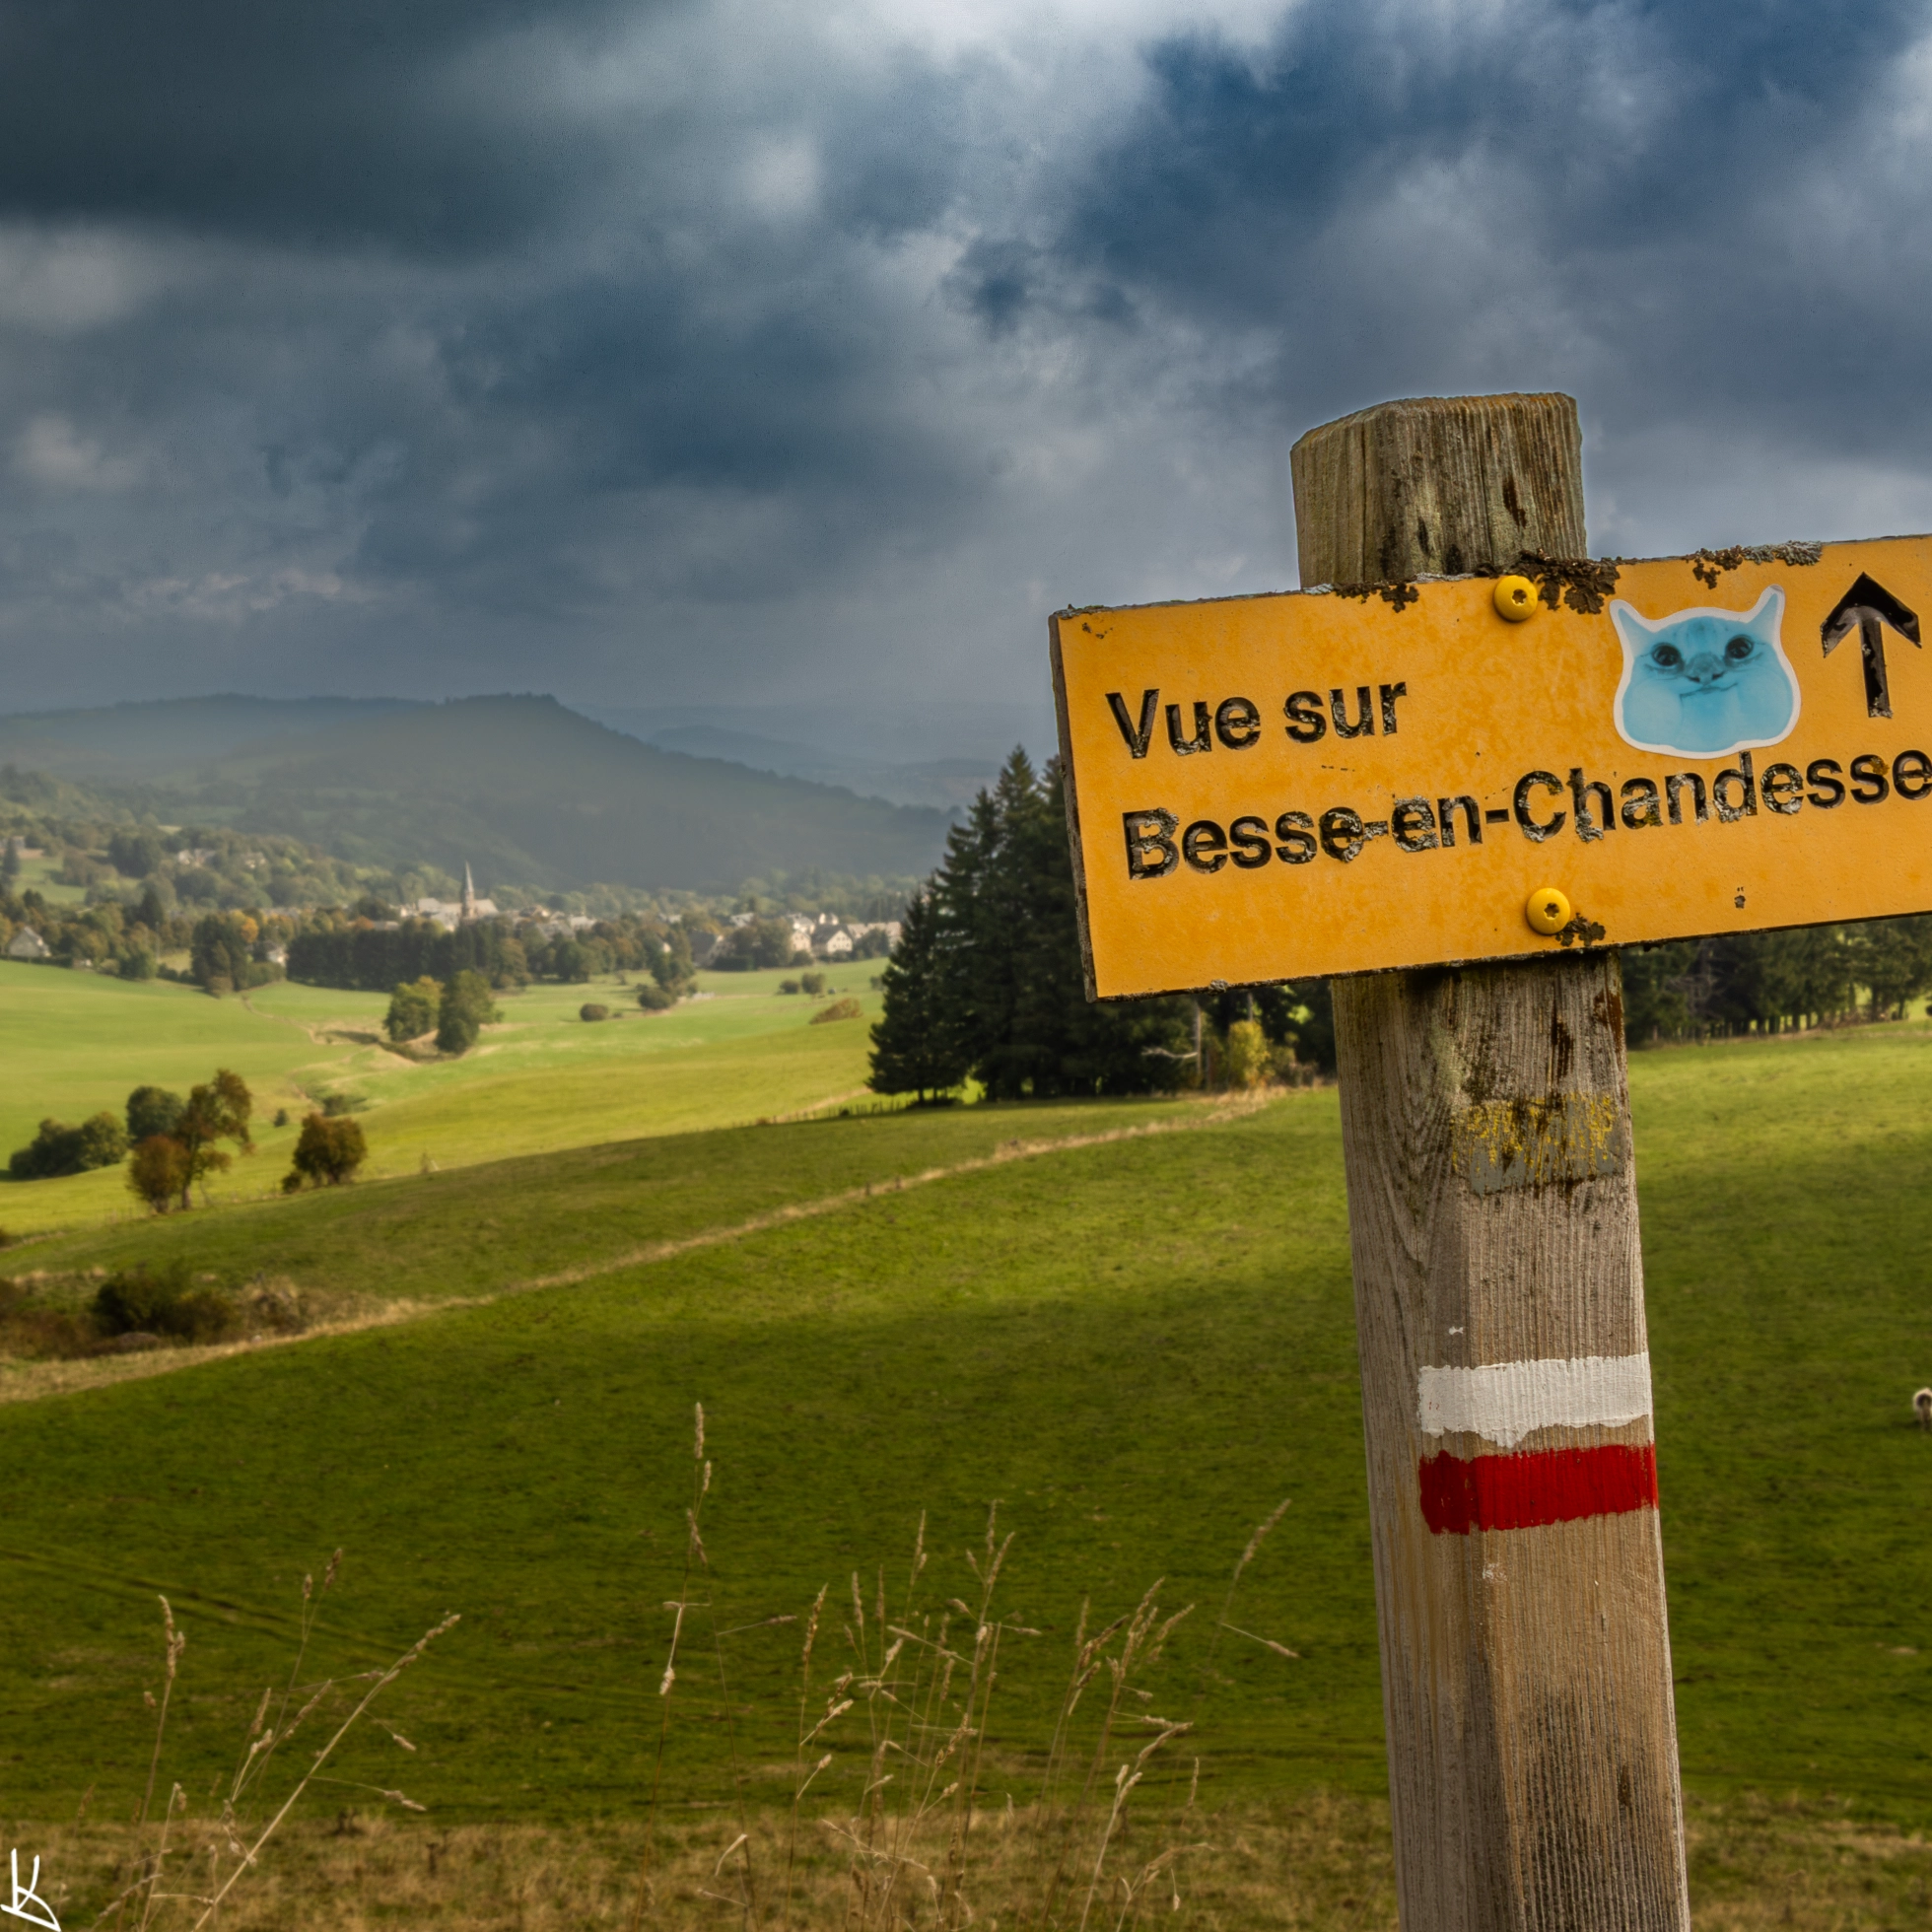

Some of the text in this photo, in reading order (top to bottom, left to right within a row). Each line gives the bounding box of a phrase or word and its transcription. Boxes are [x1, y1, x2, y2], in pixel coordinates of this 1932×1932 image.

[1105, 681, 1408, 760] Vue sur
[1122, 749, 1932, 881] Besse-en-Chandesse
